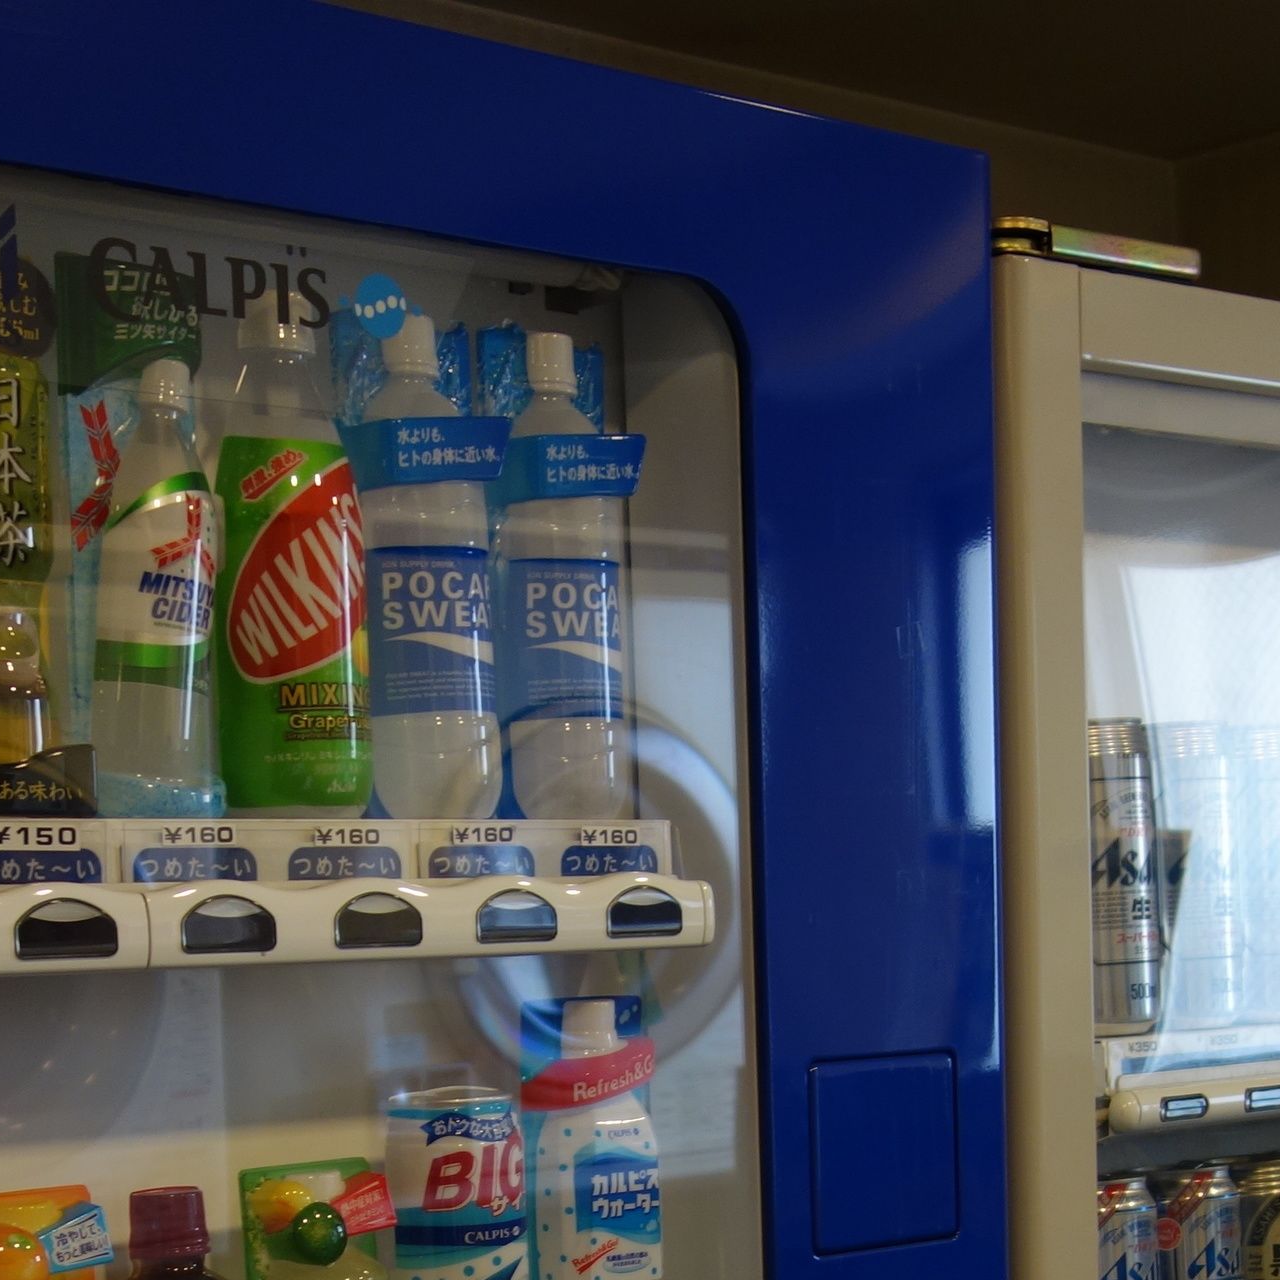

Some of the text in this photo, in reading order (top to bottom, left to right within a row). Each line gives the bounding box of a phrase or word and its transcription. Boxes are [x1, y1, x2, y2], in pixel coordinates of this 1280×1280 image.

[151, 598, 211, 632] CIDER
[164, 826, 234, 844] ¥160
[316, 828, 380, 844] ¥160
[454, 827, 513, 843] ¥160
[583, 828, 638, 845] ¥160
[464, 1227, 510, 1245] CALPIS
